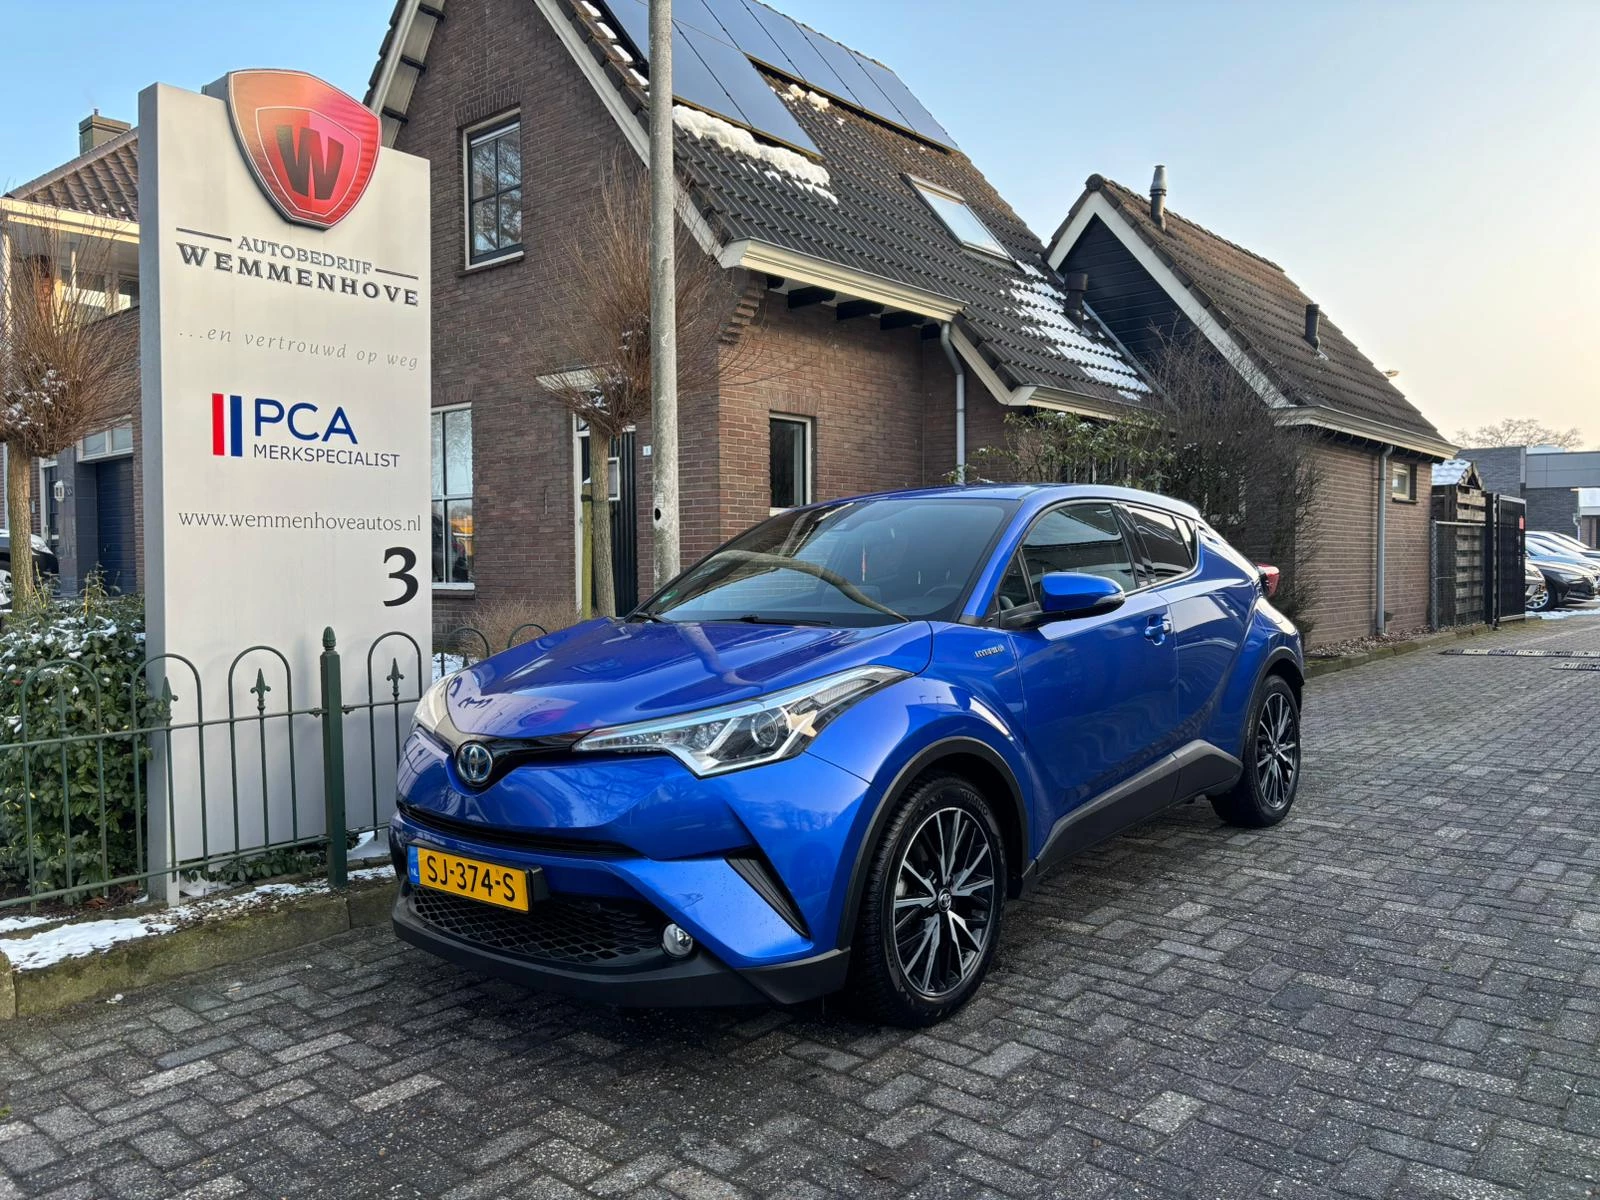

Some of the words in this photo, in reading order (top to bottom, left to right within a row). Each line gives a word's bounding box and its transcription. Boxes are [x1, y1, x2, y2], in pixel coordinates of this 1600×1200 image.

[275, 124, 345, 201] W
[176, 241, 419, 307] WEMMENHOVE
[238, 235, 373, 275] AUTOBEDRIJF
[244, 332, 347, 359] vertrouwd
[356, 349, 377, 365] op
[387, 353, 418, 371] weg
[254, 397, 359, 445] PCA
[253, 443, 401, 468] MERKSPECIALIST
[178, 511, 422, 531] www.wemmenhoveautos.nl
[382, 546, 419, 607] 3
[426, 855, 516, 902] SJ-374-S
